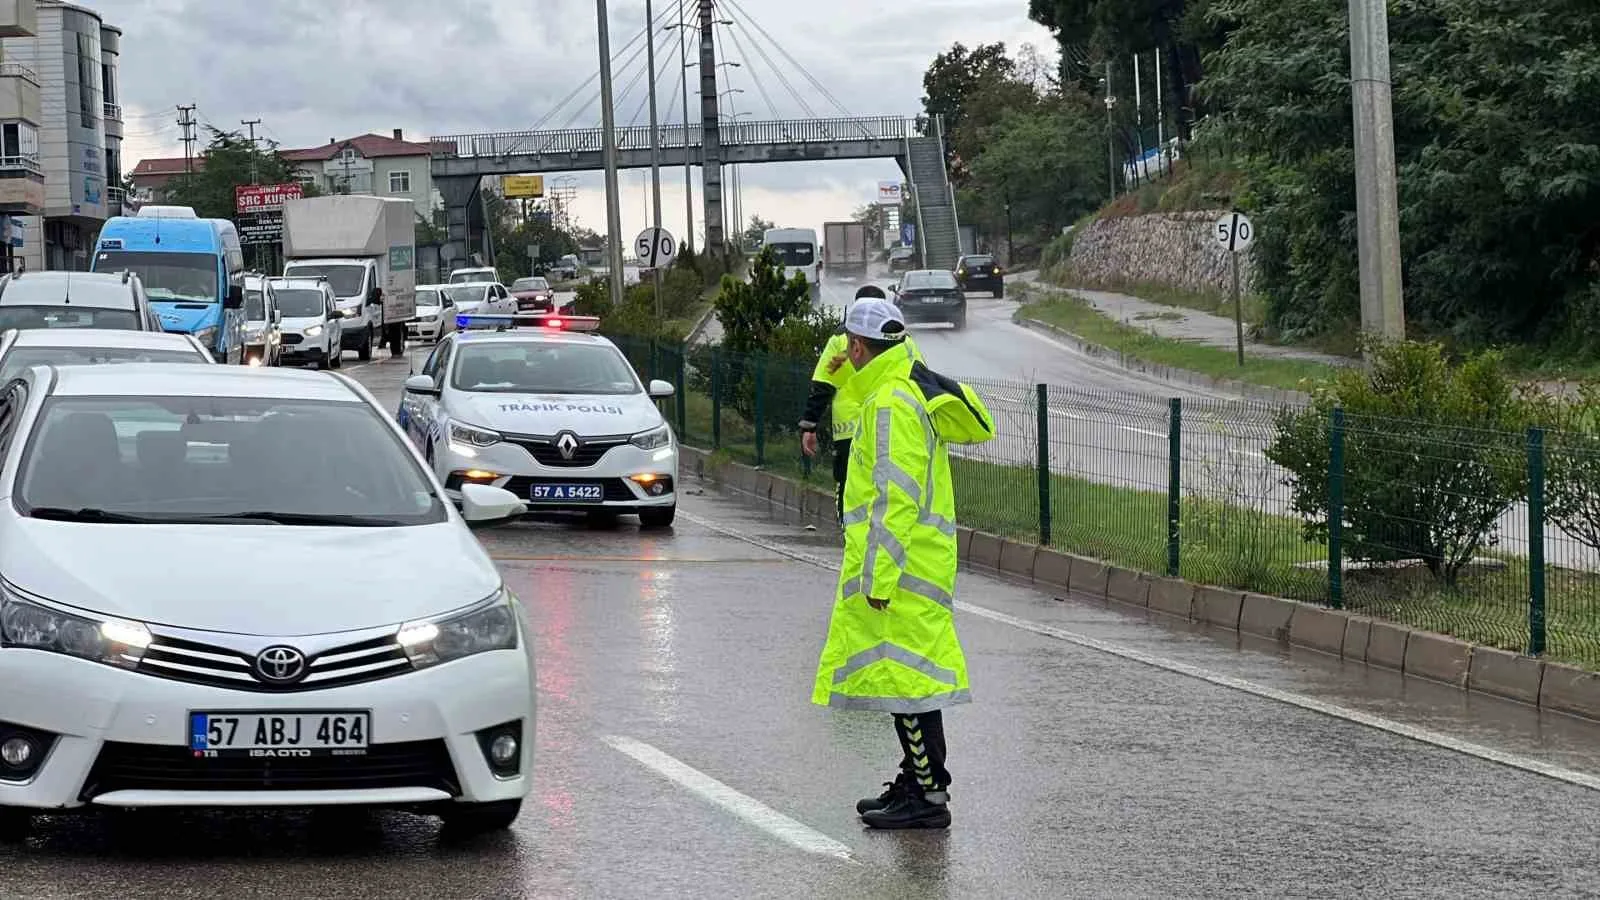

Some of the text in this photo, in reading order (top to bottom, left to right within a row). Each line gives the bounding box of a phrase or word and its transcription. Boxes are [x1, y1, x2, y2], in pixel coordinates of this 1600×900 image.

[239, 195, 261, 206] SRC
[534, 486, 601, 498] 57 A 5422
[207, 716, 363, 746] 57 ABJ 464
[277, 749, 311, 757] OTO
